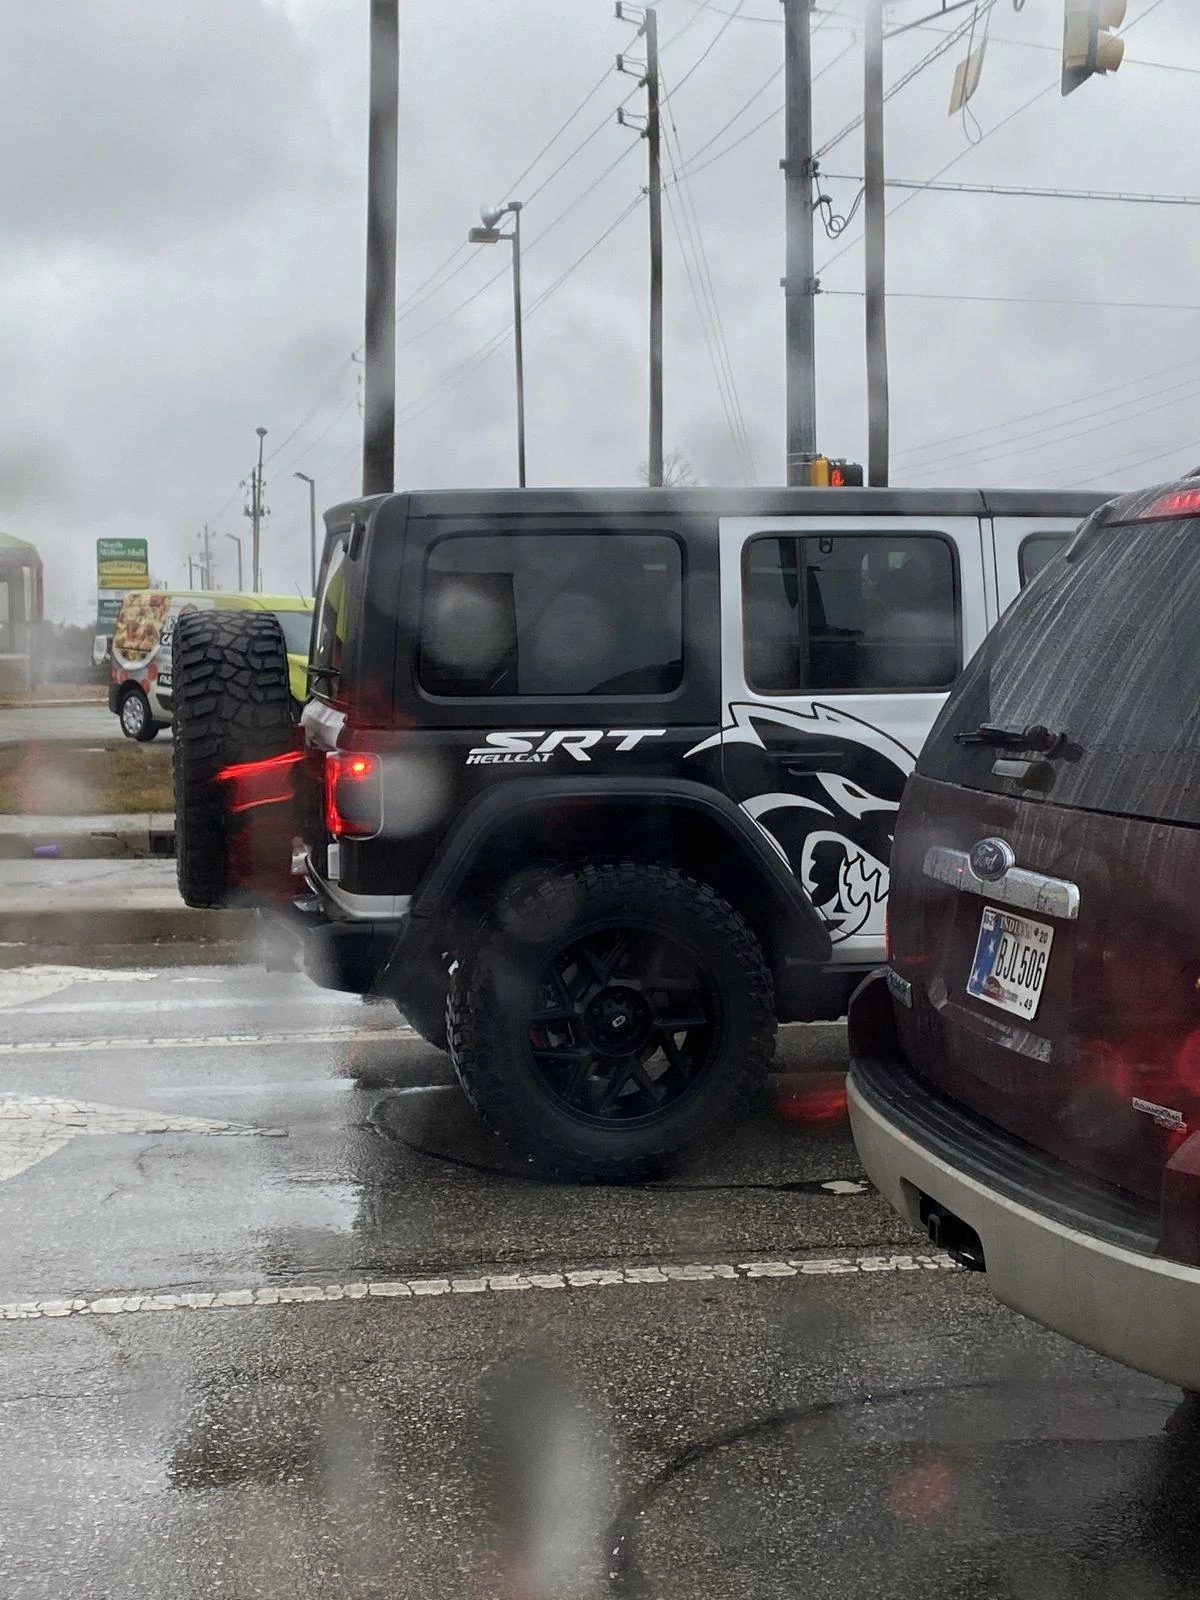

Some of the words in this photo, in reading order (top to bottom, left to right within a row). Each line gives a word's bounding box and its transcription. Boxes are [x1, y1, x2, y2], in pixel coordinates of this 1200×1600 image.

[465, 752, 554, 765] HELLCAT
[468, 729, 667, 762] SRT
[973, 844, 999, 870] Ford
[994, 937, 1046, 992] BJL506
[1023, 998, 1033, 1011] 49
